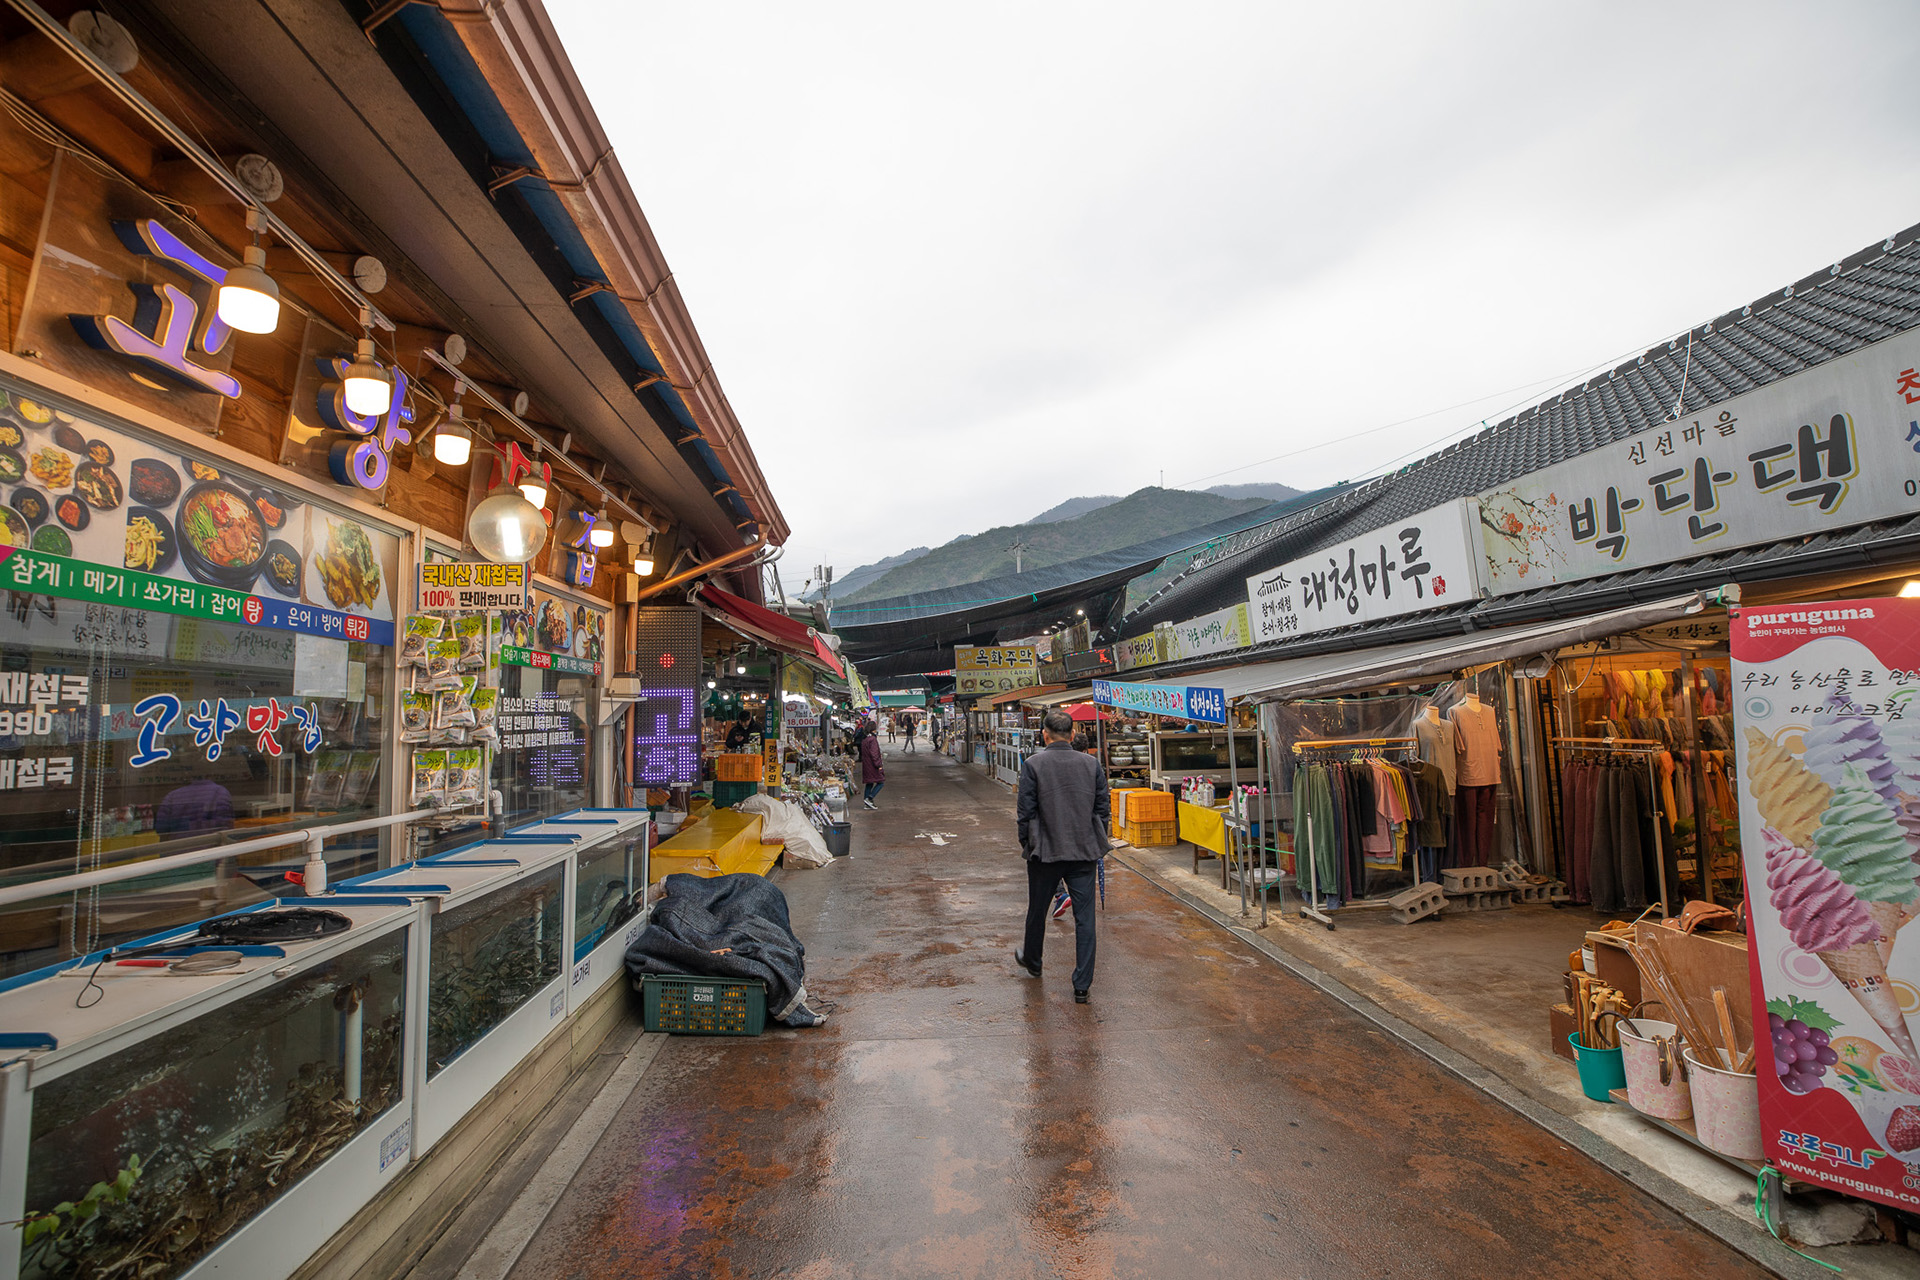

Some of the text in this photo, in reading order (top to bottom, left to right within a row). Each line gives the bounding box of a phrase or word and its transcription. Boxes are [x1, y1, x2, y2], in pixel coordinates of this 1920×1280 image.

[1627, 409, 1738, 466] 신선마을
[1568, 413, 1859, 558] 박단댁
[423, 564, 523, 587] 국내산 재첩국
[1300, 527, 1431, 614] 대청마루
[12, 554, 61, 587] 참게
[83, 570, 124, 597] 메기
[143, 582, 195, 608] 쏘가리
[287, 607, 311, 627] 은어
[321, 614, 342, 632] 빙어
[347, 618, 368, 638] 튀김
[423, 590, 455, 607] 100%
[1747, 607, 1875, 628] puruguna
[1749, 625, 1846, 638] 농민이 꾸려가는 농업회사
[975, 648, 1033, 668] 옥화주막
[1741, 671, 1779, 692] 우리
[1190, 689, 1221, 718] 대청마루
[1790, 699, 1907, 722] 아이스크림
